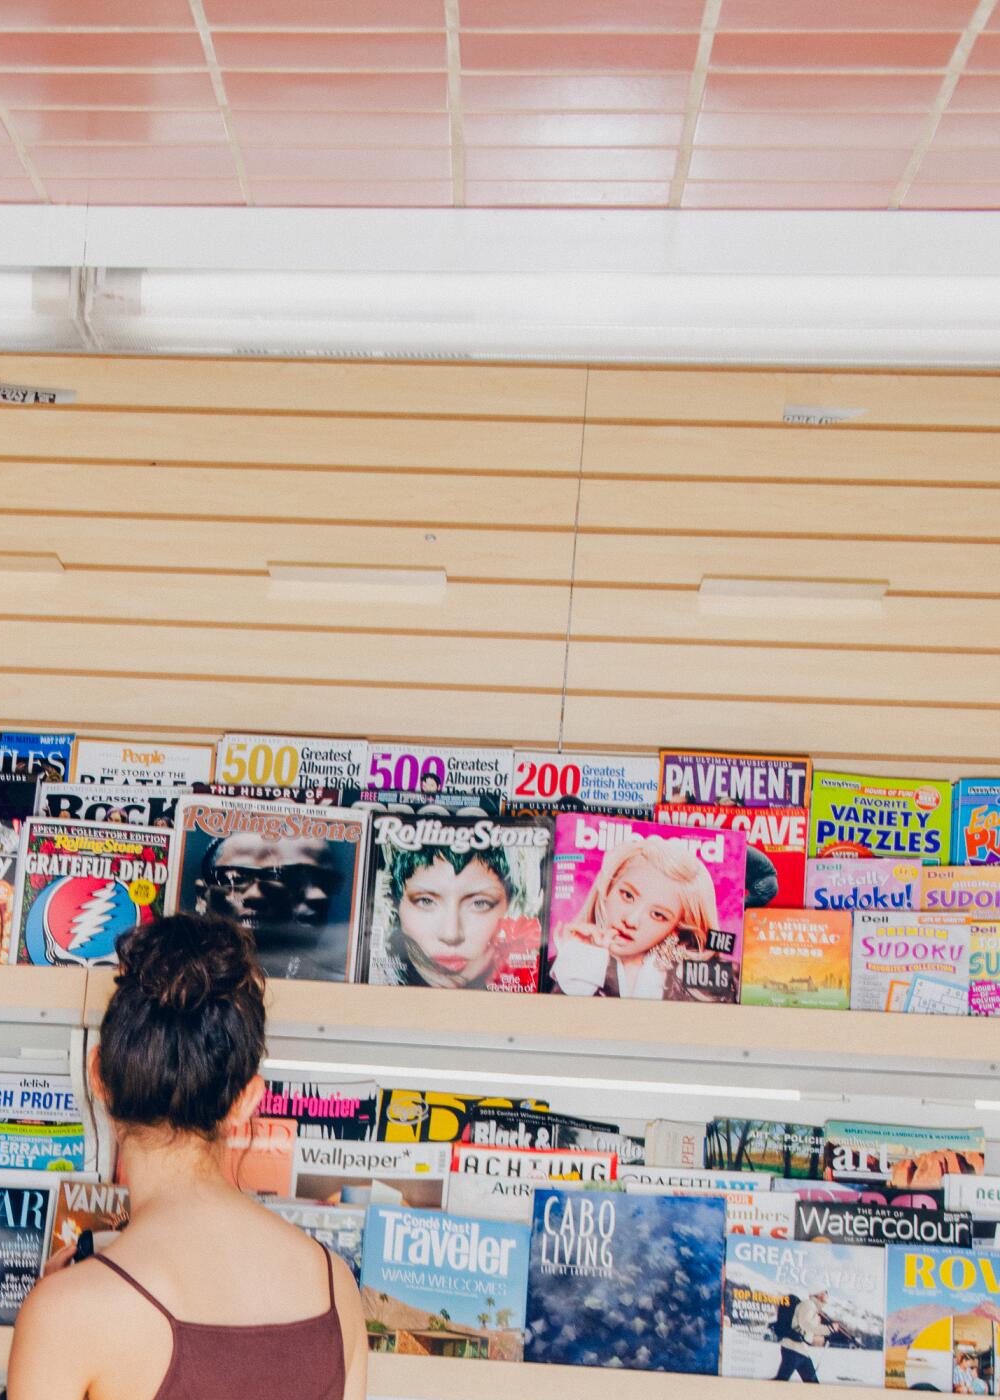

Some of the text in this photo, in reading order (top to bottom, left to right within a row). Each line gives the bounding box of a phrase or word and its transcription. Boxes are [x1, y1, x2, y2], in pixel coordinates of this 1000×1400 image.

[301, 747, 352, 761] Greatest
[101, 767, 185, 779] THE STORY OF THE
[222, 743, 300, 788] 500
[300, 761, 361, 777] Albums Of
[367, 752, 445, 791] 500
[447, 758, 499, 772] Greatest
[582, 765, 624, 777] Greatest
[0, 774, 27, 782] GUIDE
[299, 775, 360, 790] The 1960s
[446, 772, 508, 787] Albums Of
[515, 762, 581, 798] 200
[581, 777, 658, 791] British Records
[664, 763, 806, 805] PAVEMENT
[91, 795, 139, 804] CLASSIC
[210, 785, 234, 795] THE
[241, 786, 300, 799] HISTORY
[305, 789, 324, 799] OF
[581, 789, 643, 802] of the 1990s
[45, 793, 180, 827] ROCK
[506, 802, 650, 816] THE ULTIMATE MUSIC GUIDE
[854, 797, 908, 808] FAVORITE
[182, 805, 362, 843] Rolling Stone
[831, 805, 930, 828] VARIETY
[373, 816, 553, 854] Rolling Stone
[731, 815, 806, 845] CAVE
[816, 820, 941, 854] PUZZLES
[55, 834, 143, 855] Rolling Stone
[25, 852, 168, 885] GRATEFUL DEAD
[816, 863, 842, 872] Dell
[928, 870, 954, 879] Dell
[828, 872, 889, 887] Totally
[814, 884, 912, 910] Sudoku!
[861, 915, 889, 923] Dell
[709, 930, 734, 953] THE
[757, 931, 840, 944] ALMANAC
[861, 936, 963, 961] SUDOKU
[19, 1079, 50, 1088] delish
[475, 1120, 551, 1149] Black &
[832, 1144, 892, 1175] art
[543, 1196, 616, 1239] CABO
[857, 1207, 874, 1215] THE
[442, 1220, 471, 1235] Nast
[799, 1205, 969, 1244] Watercolour
[378, 1208, 517, 1279] Traveler
[540, 1233, 614, 1269] LIVING
[735, 1242, 808, 1266] GREAT
[733, 1289, 790, 1307] TOP RESORTS
